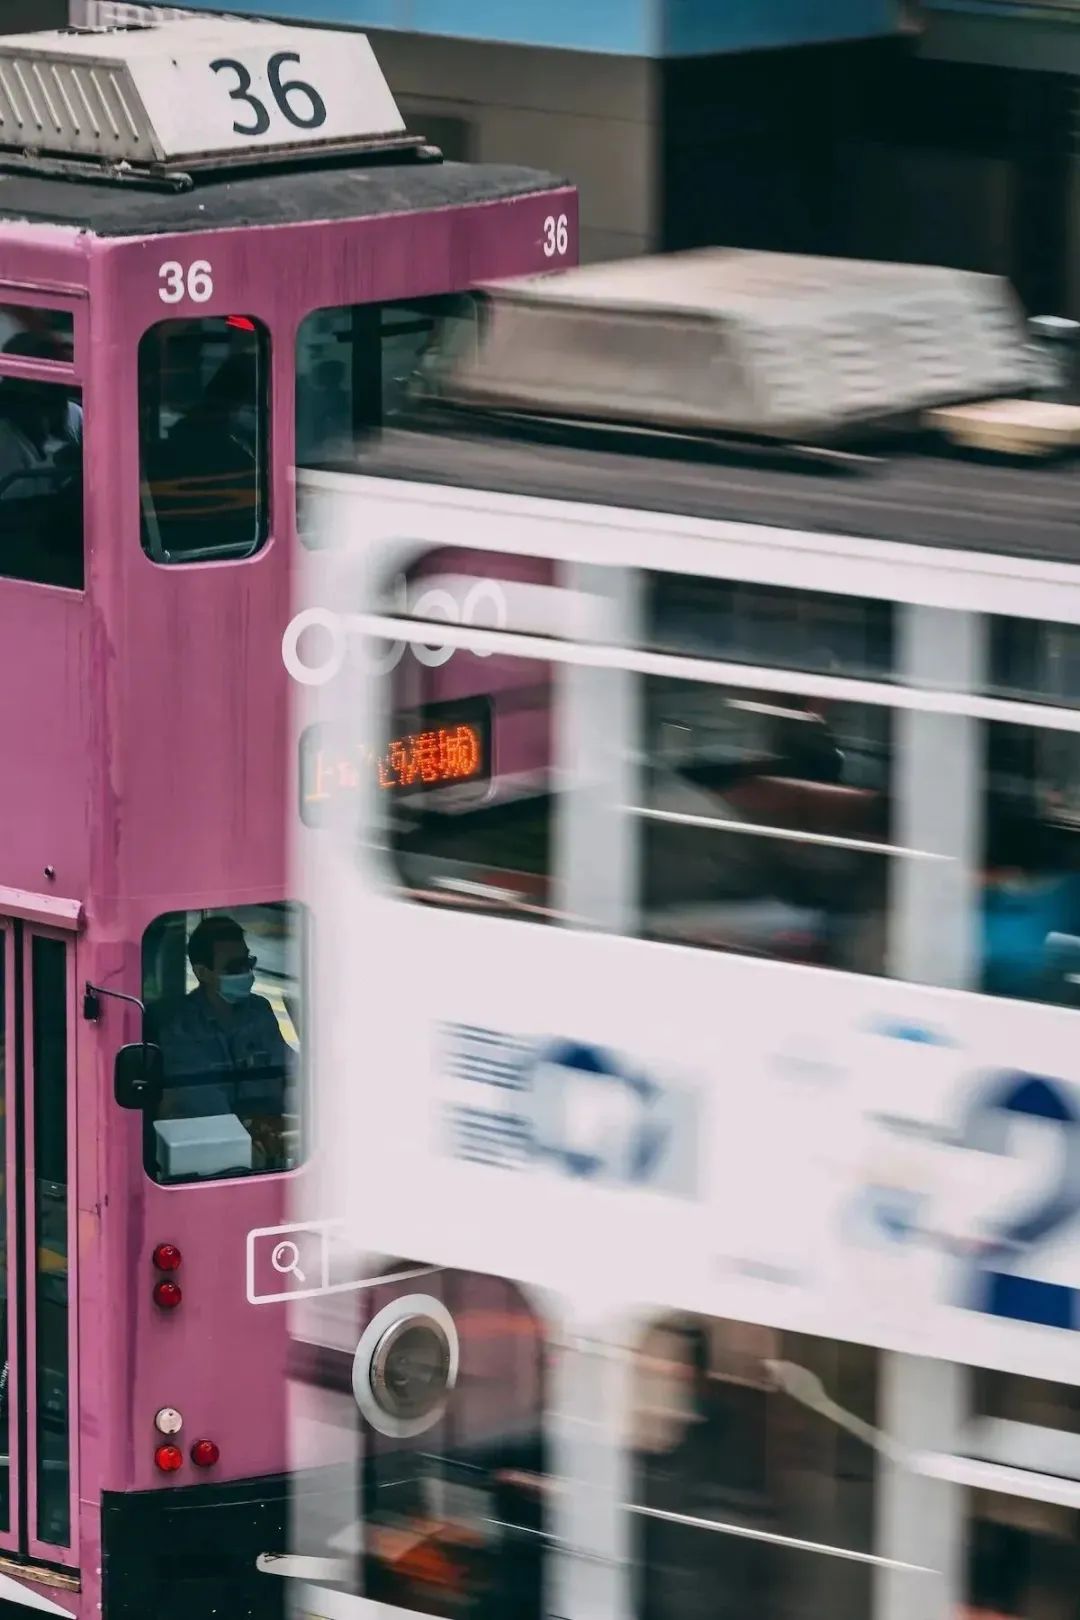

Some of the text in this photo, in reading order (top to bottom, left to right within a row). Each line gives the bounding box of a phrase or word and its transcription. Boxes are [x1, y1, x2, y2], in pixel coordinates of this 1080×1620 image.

[208, 51, 327, 136] 36
[543, 213, 568, 257] 36
[158, 260, 213, 303] 36
